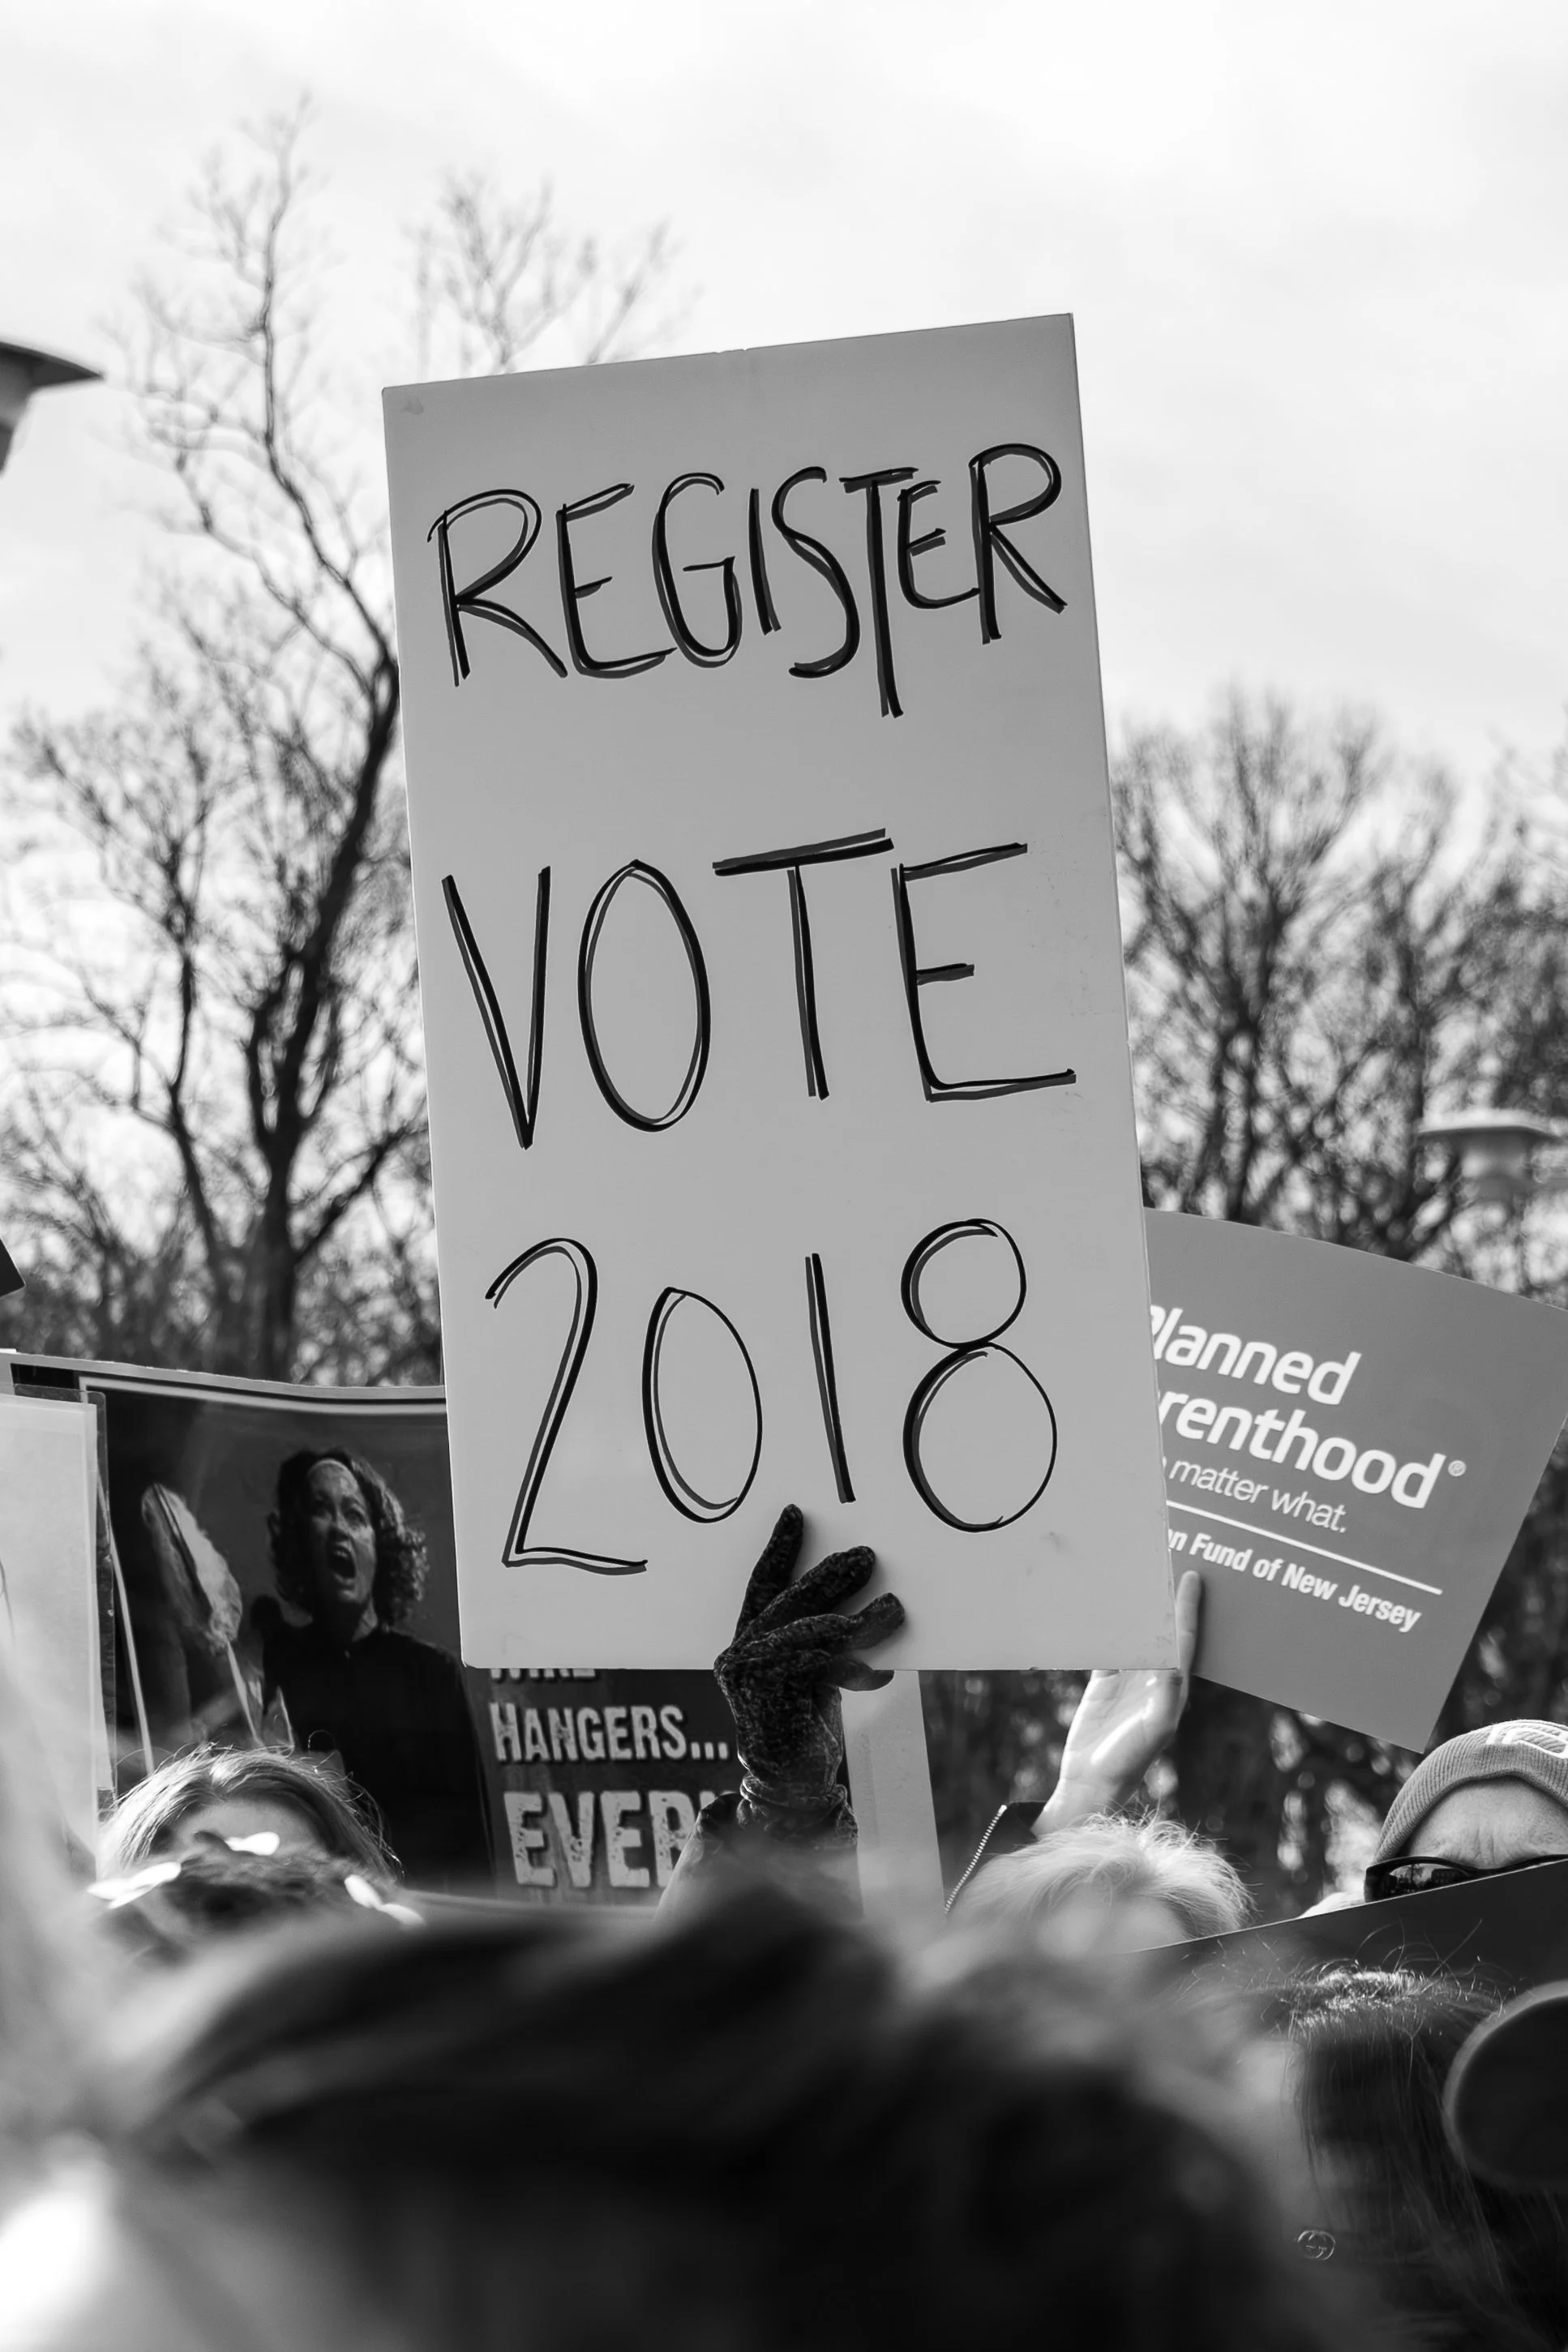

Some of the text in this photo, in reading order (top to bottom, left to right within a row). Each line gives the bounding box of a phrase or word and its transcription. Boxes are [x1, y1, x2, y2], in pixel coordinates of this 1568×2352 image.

[427, 443, 1068, 718] REGISTER
[441, 828, 1077, 1150] VOTE
[485, 1218, 1057, 1575] 2018
[1169, 1460, 1347, 1532] matter what.
[1189, 1532, 1253, 1572] Fund
[1253, 1558, 1284, 1581] of
[1281, 1563, 1338, 1600] New
[1339, 1584, 1423, 1633] Jersey
[490, 1702, 728, 1762] HANGERS...
[503, 1790, 735, 1887] EVER
